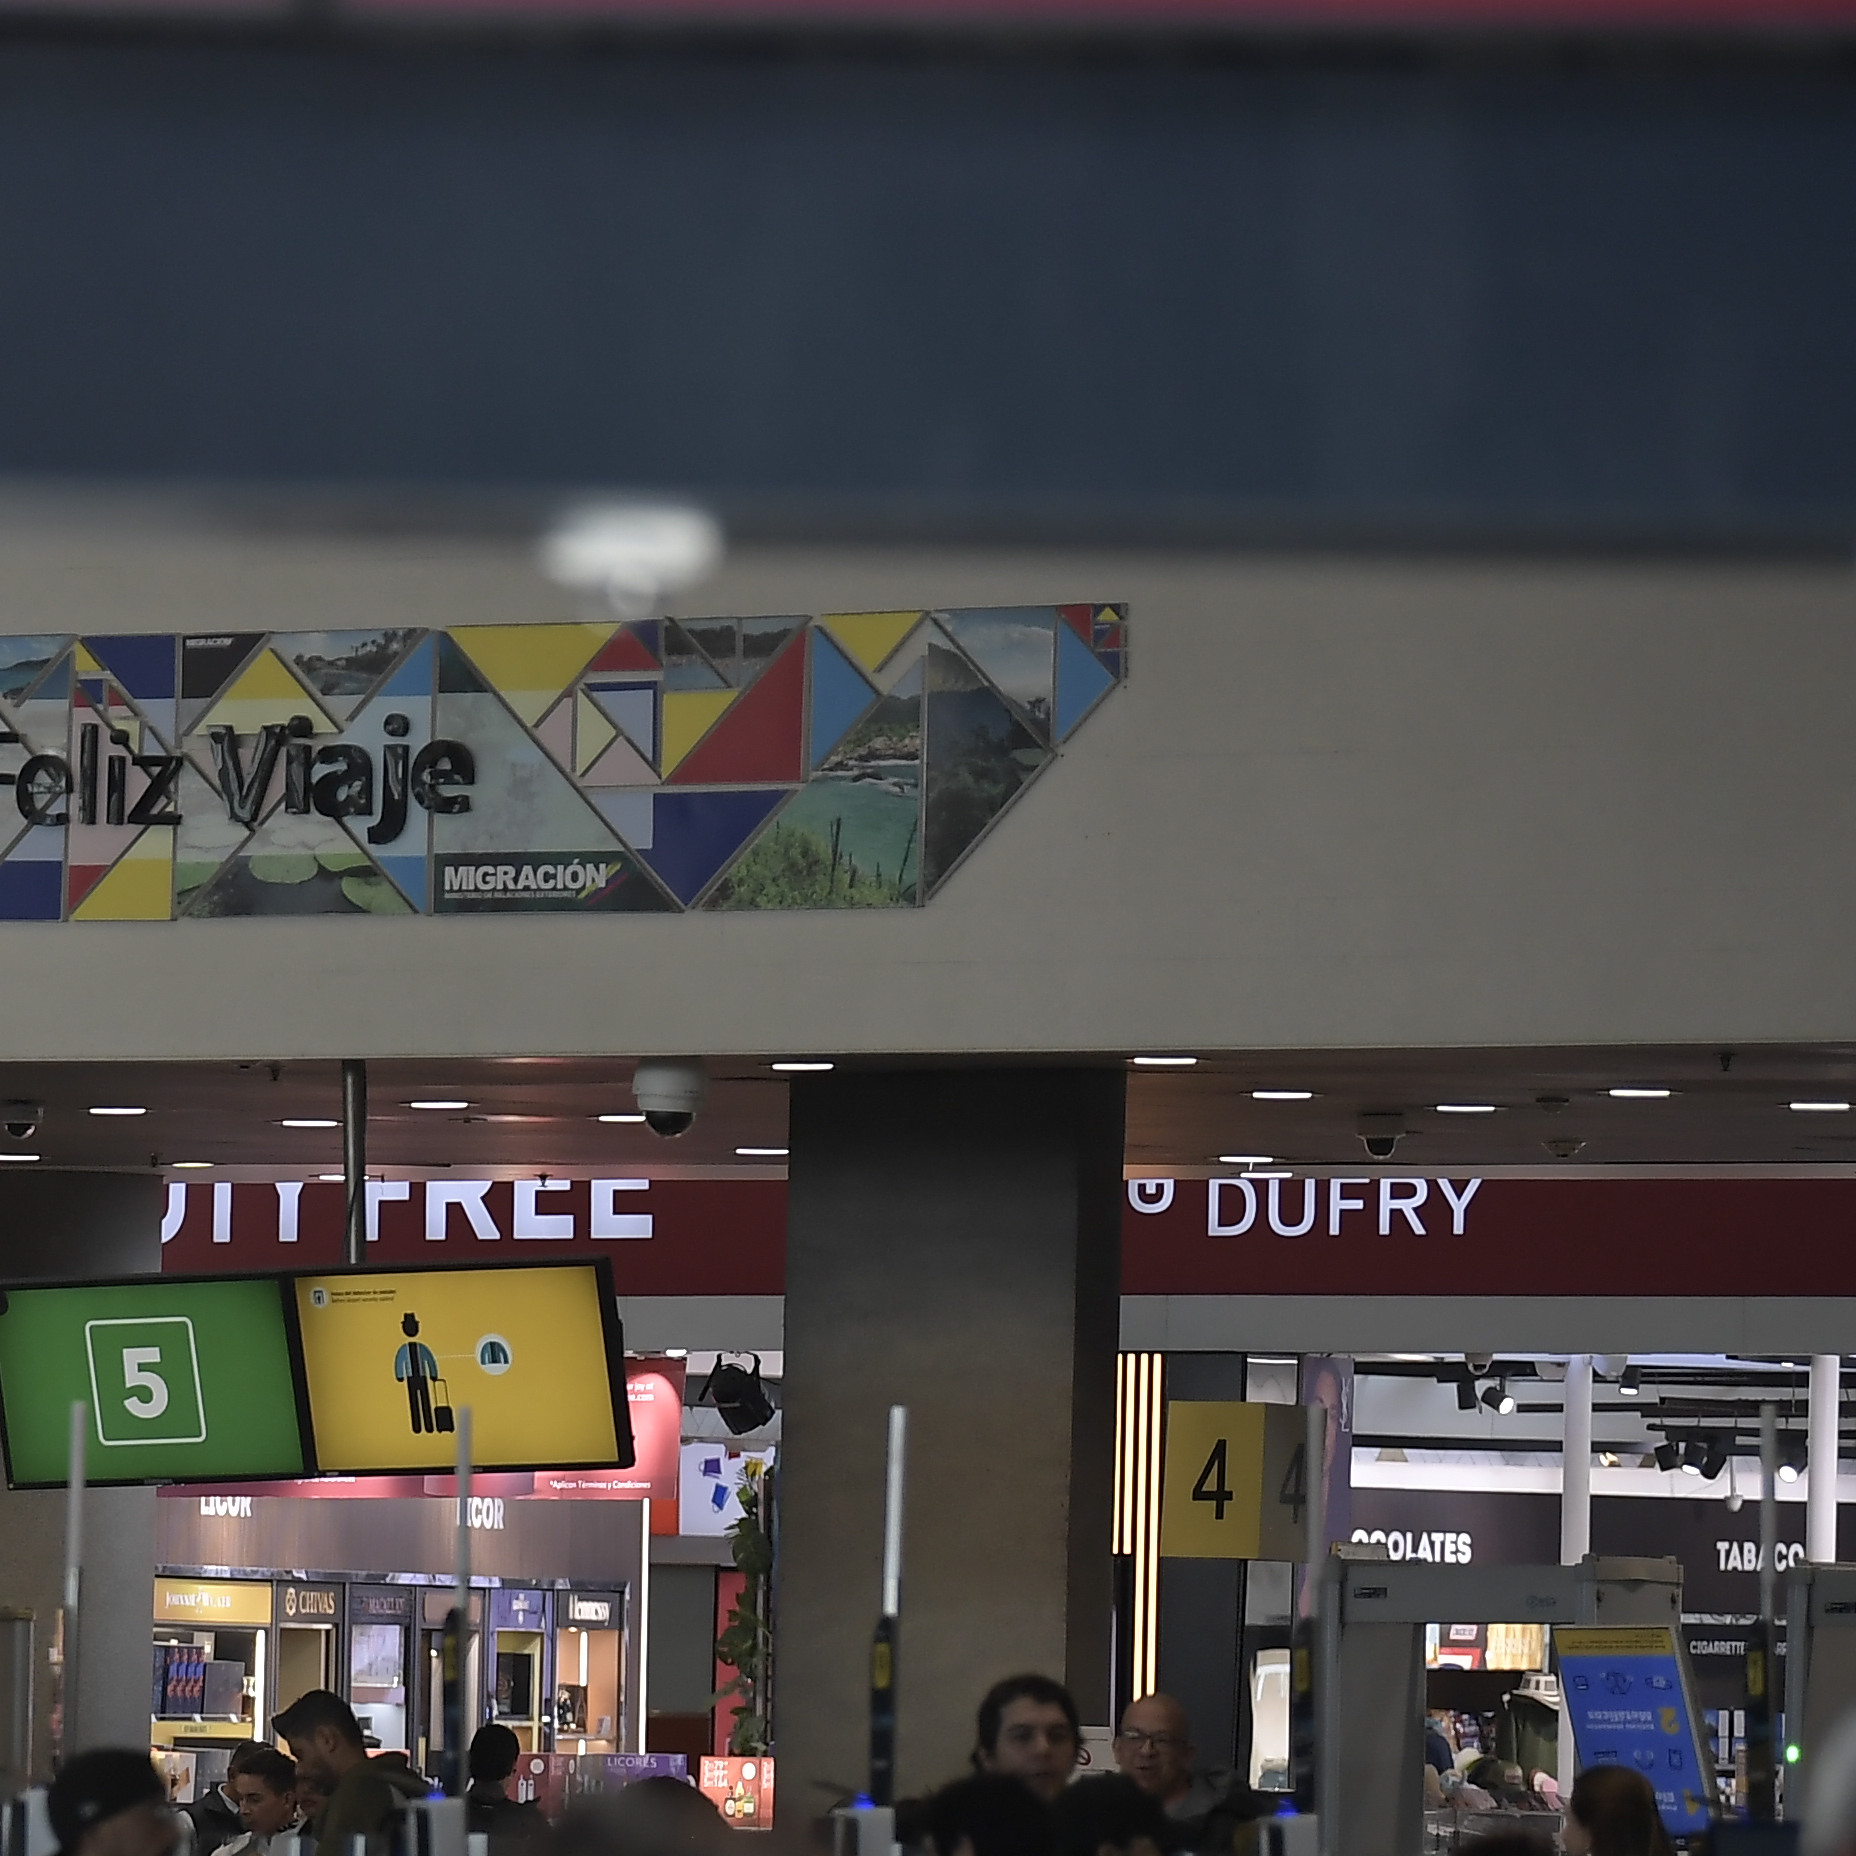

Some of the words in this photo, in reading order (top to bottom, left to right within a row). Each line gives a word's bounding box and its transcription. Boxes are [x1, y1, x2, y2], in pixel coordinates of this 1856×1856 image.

[208, 713, 476, 846] Viaje
[444, 858, 607, 891] MIGRACIÓN
[1207, 1177, 1483, 1237] DUFRY
[122, 1346, 170, 1419] 5
[1192, 1438, 1234, 1521] 4
[299, 1591, 335, 1615] CHIVAS
[606, 1756, 658, 1770] LICORES
